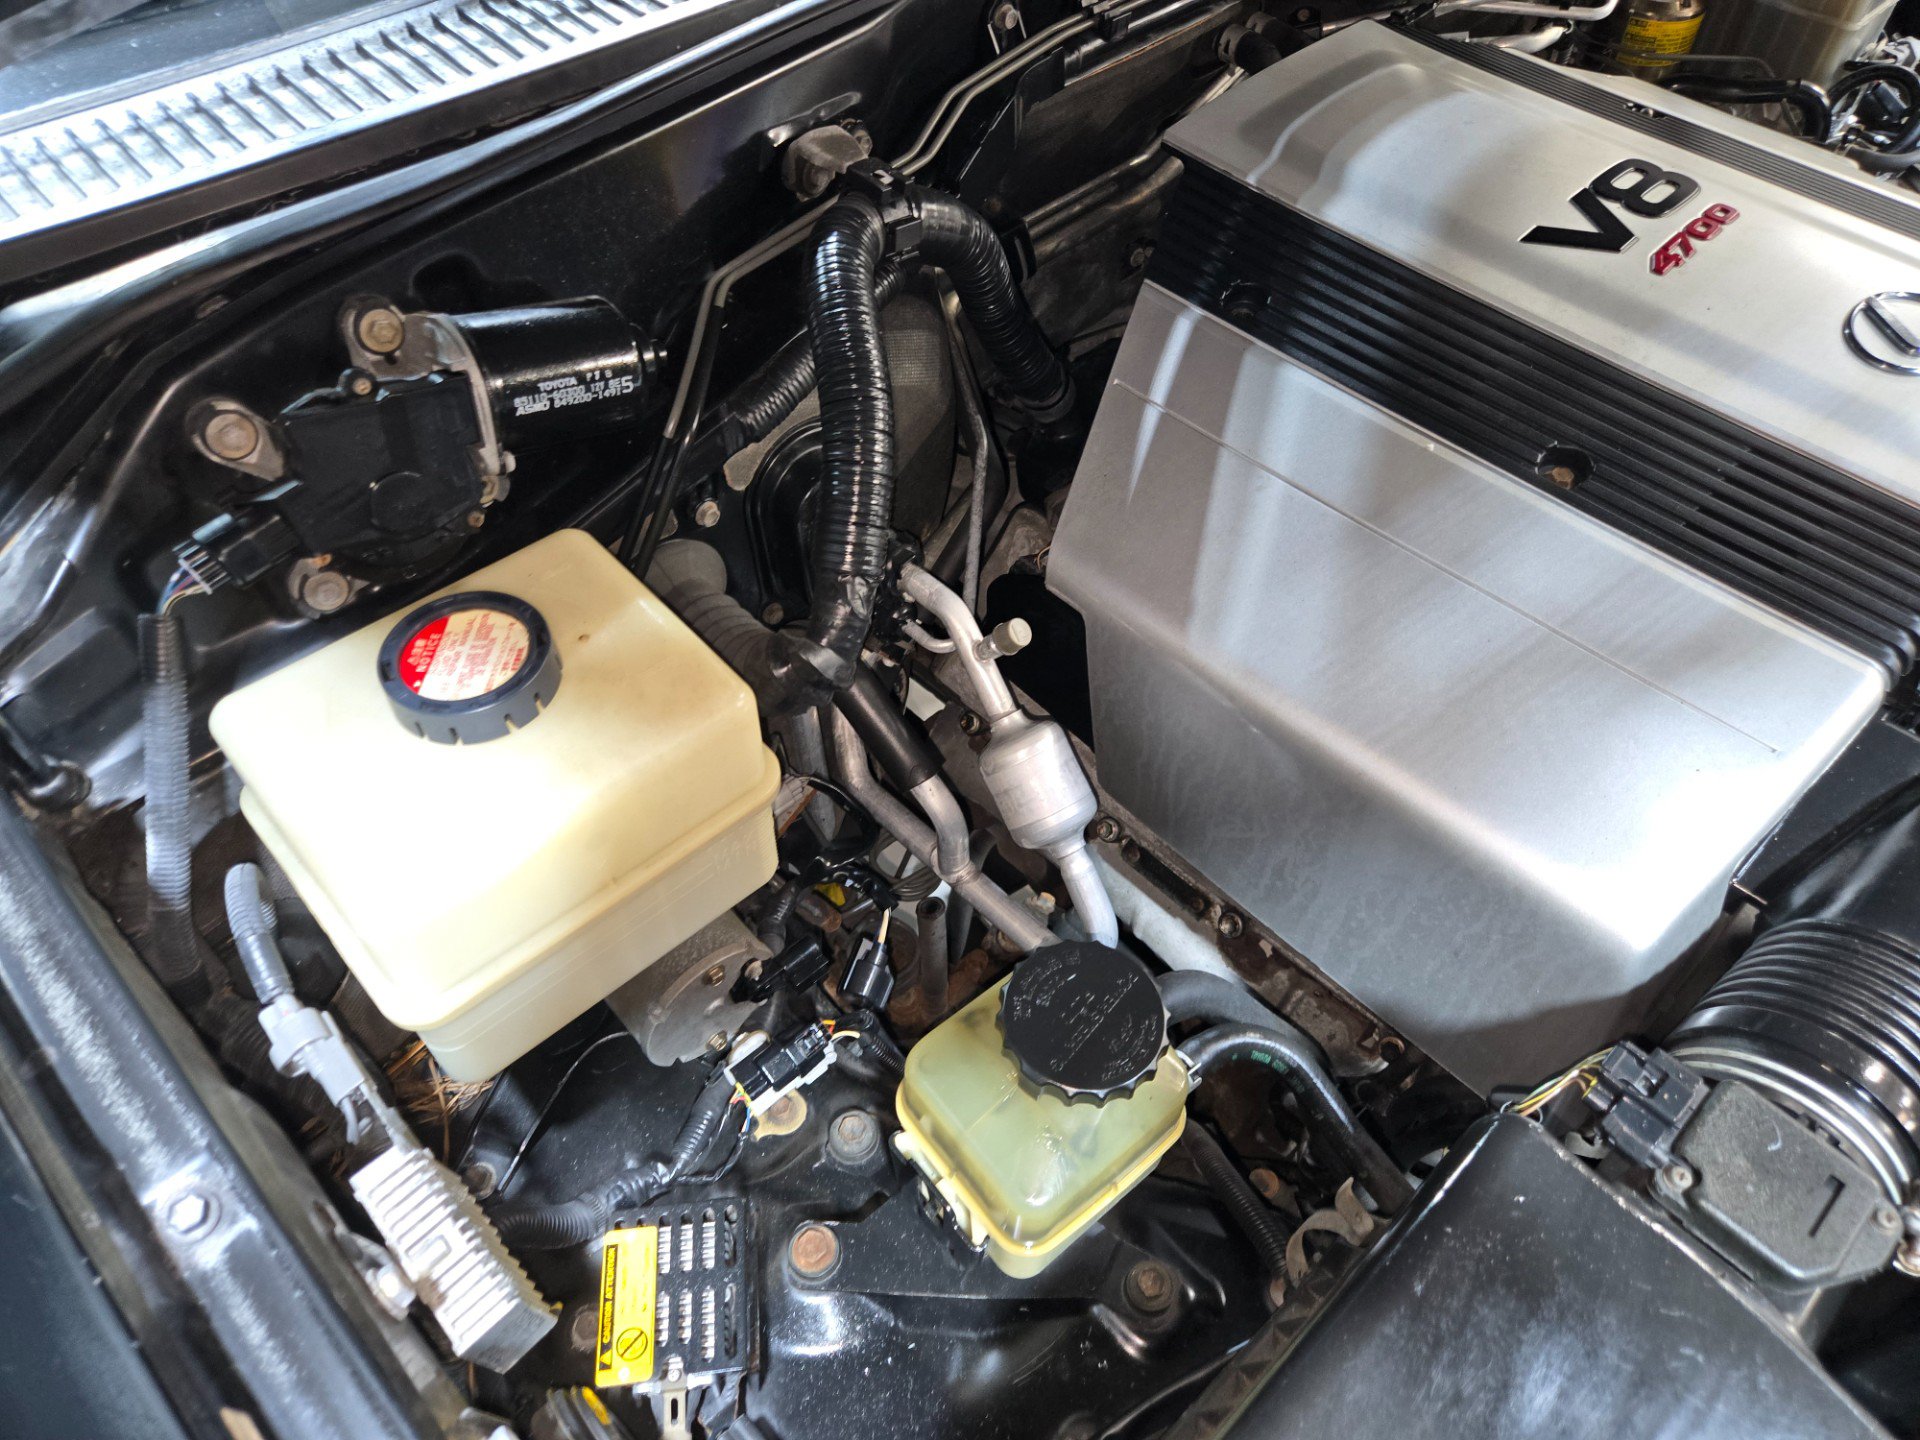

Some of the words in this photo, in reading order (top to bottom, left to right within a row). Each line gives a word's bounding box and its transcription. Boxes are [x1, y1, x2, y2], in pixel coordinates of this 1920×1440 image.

[1518, 158, 1701, 254] V8
[1649, 203, 1741, 276] 4700
[537, 377, 578, 392] TOYOTA
[621, 375, 635, 394] 5
[416, 633, 441, 673] NOTICE
[605, 1247, 617, 1300] ATTENTION
[602, 1299, 615, 1344] CAUTION
